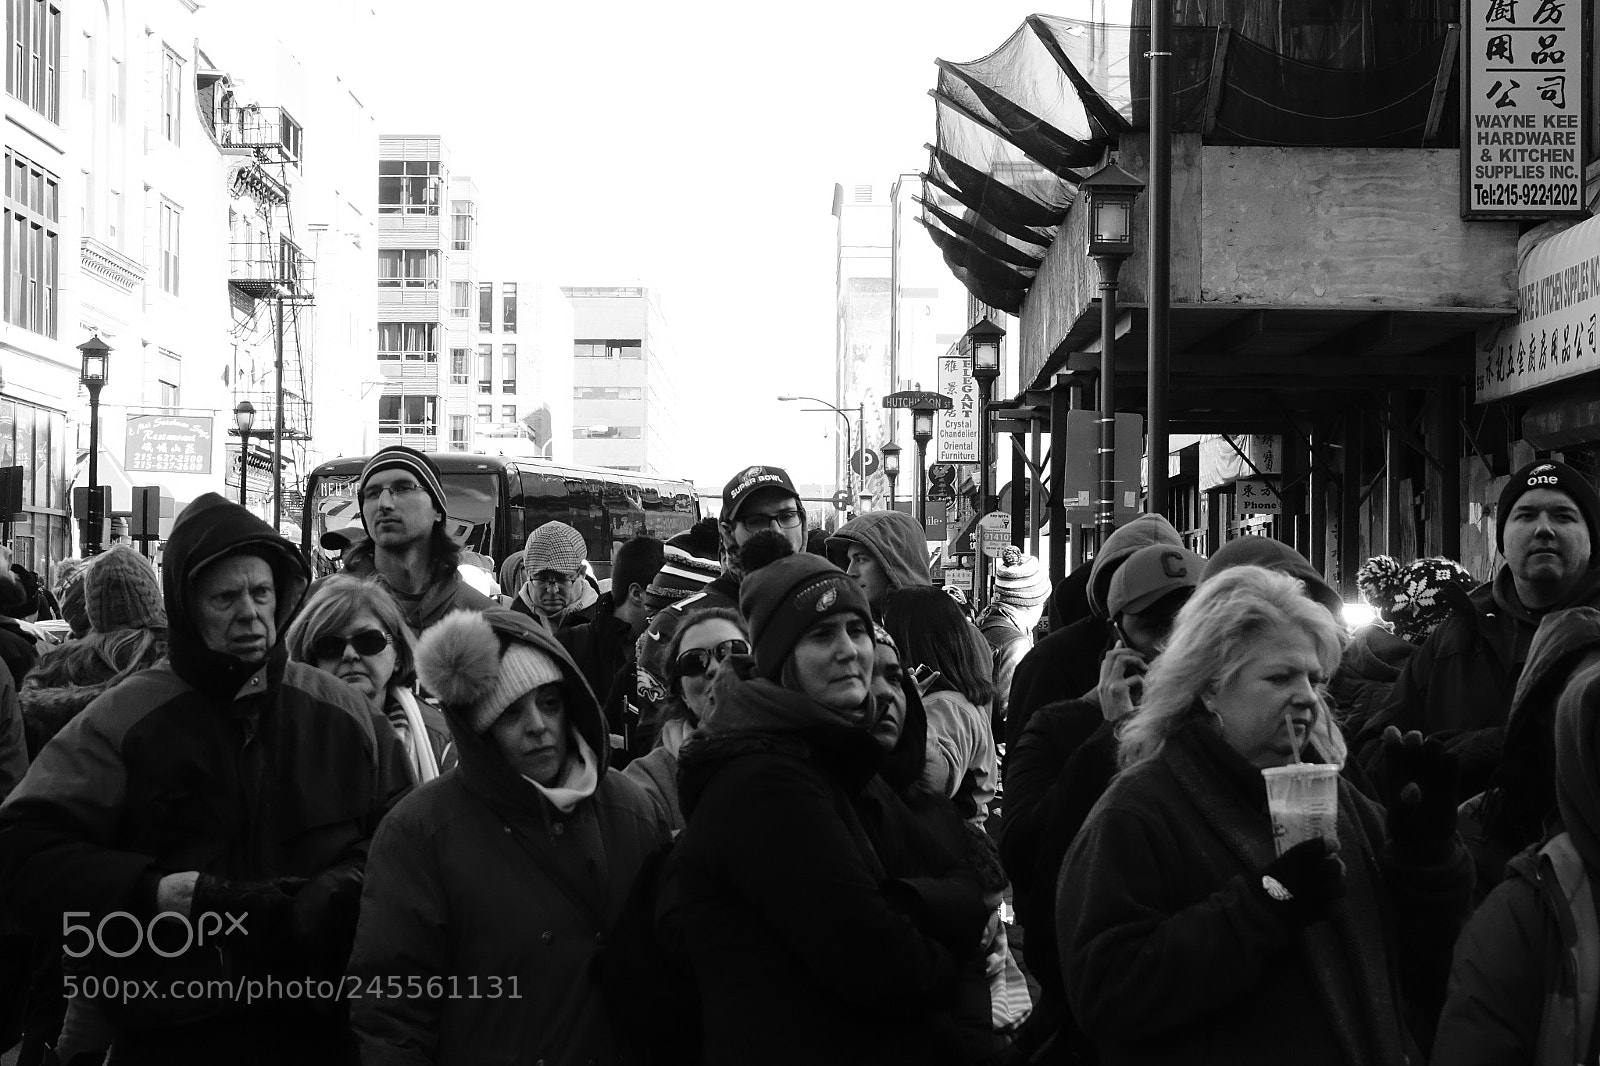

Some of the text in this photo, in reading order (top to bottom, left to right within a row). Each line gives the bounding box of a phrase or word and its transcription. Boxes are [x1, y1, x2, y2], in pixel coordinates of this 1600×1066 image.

[1486, 34, 1566, 65] 用品
[1486, 75, 1567, 109] 公司
[1475, 115, 1578, 129] WAYNE KEE
[1477, 132, 1576, 146] HARDWARE
[1480, 148, 1575, 163] & KITCHEN
[1475, 165, 1579, 179] SUPPLIES INC.
[1541, 270, 1563, 318] KITCHEN
[1564, 259, 1589, 308] SUPPLIES
[961, 359, 974, 418] ELEGANT
[945, 419, 972, 430] Crystal
[940, 429, 978, 438] Chandelier
[943, 441, 973, 450] Oriental
[941, 451, 976, 460] Furniture
[730, 474, 784, 499] SUPER BOWL
[1527, 475, 1559, 486] one
[320, 482, 342, 497] NEW
[1244, 501, 1277, 509] Phone
[1160, 551, 1188, 578] C
